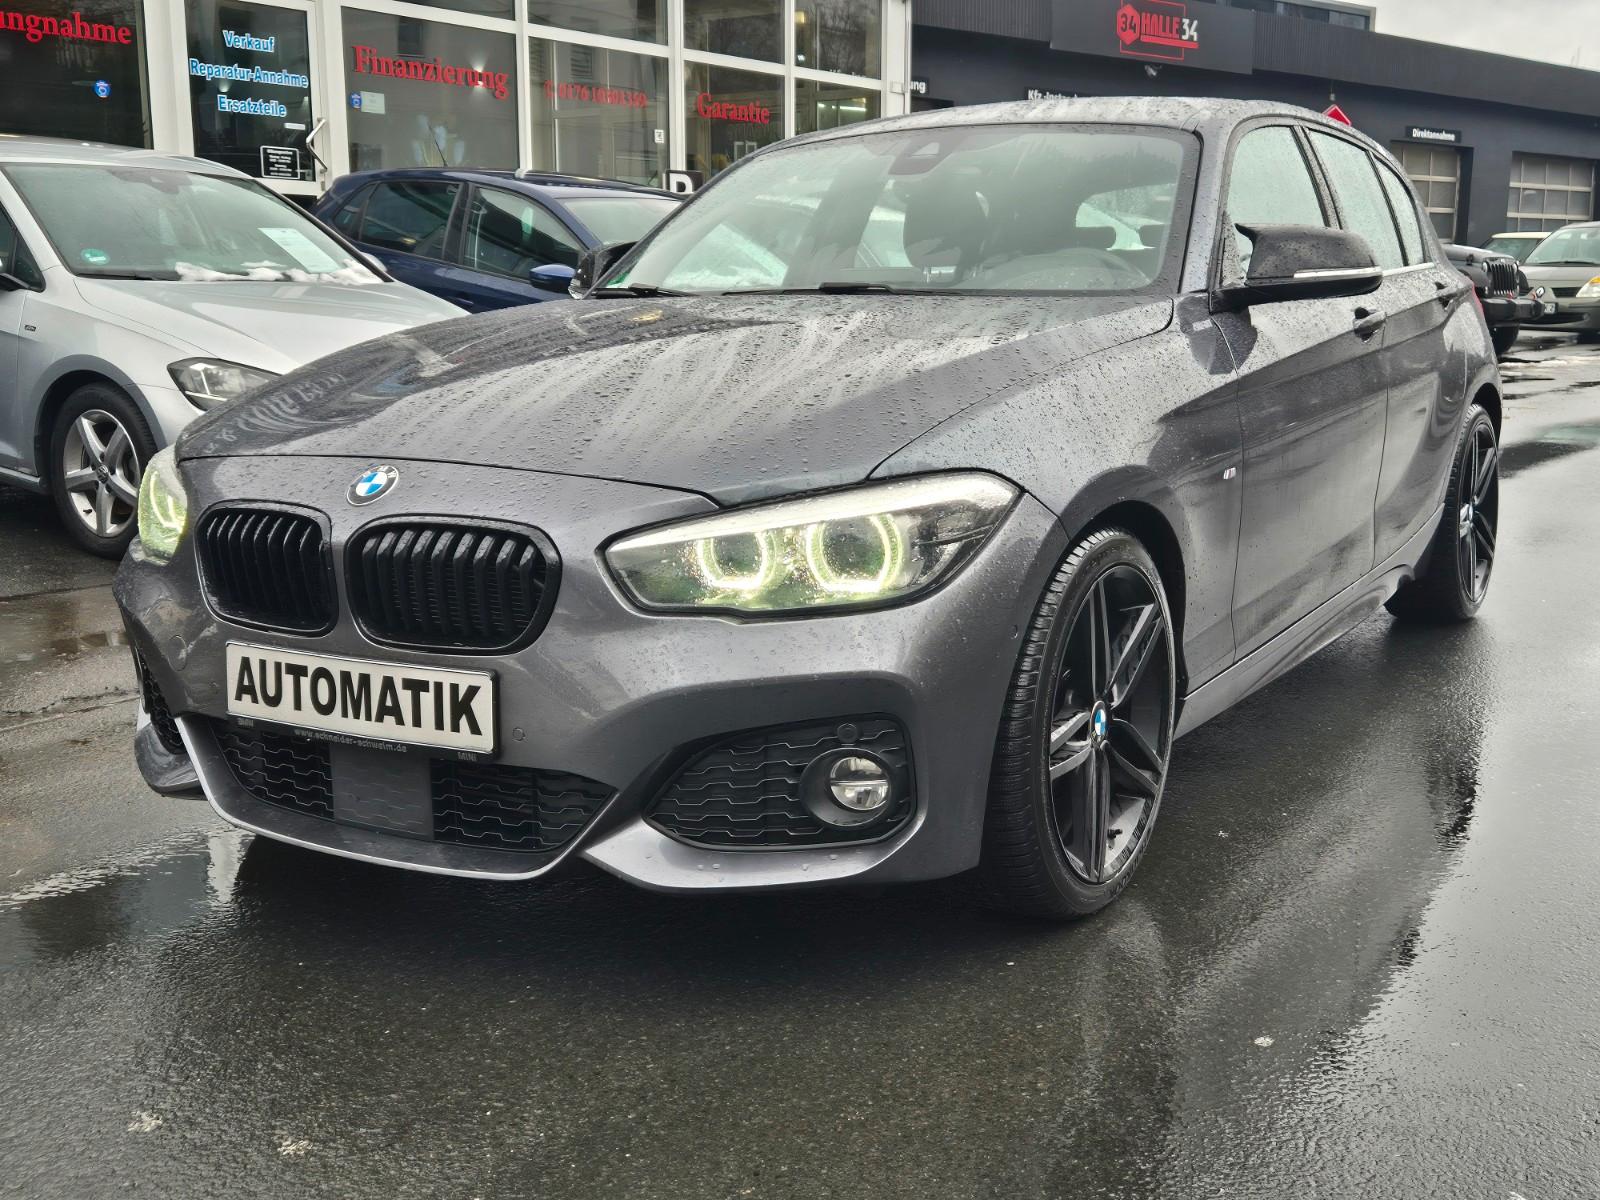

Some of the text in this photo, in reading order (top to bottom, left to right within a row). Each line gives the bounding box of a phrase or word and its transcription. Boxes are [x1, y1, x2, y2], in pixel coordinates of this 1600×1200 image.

[0, 11, 132, 44] ngnahme
[223, 30, 275, 53] Verkauf
[189, 58, 309, 89] Reparatur-Annahme
[351, 45, 509, 99] Finanzierung
[217, 94, 287, 117] Ersatzteile
[697, 92, 770, 124] Garantie
[234, 656, 483, 736] AUTOMATIK
